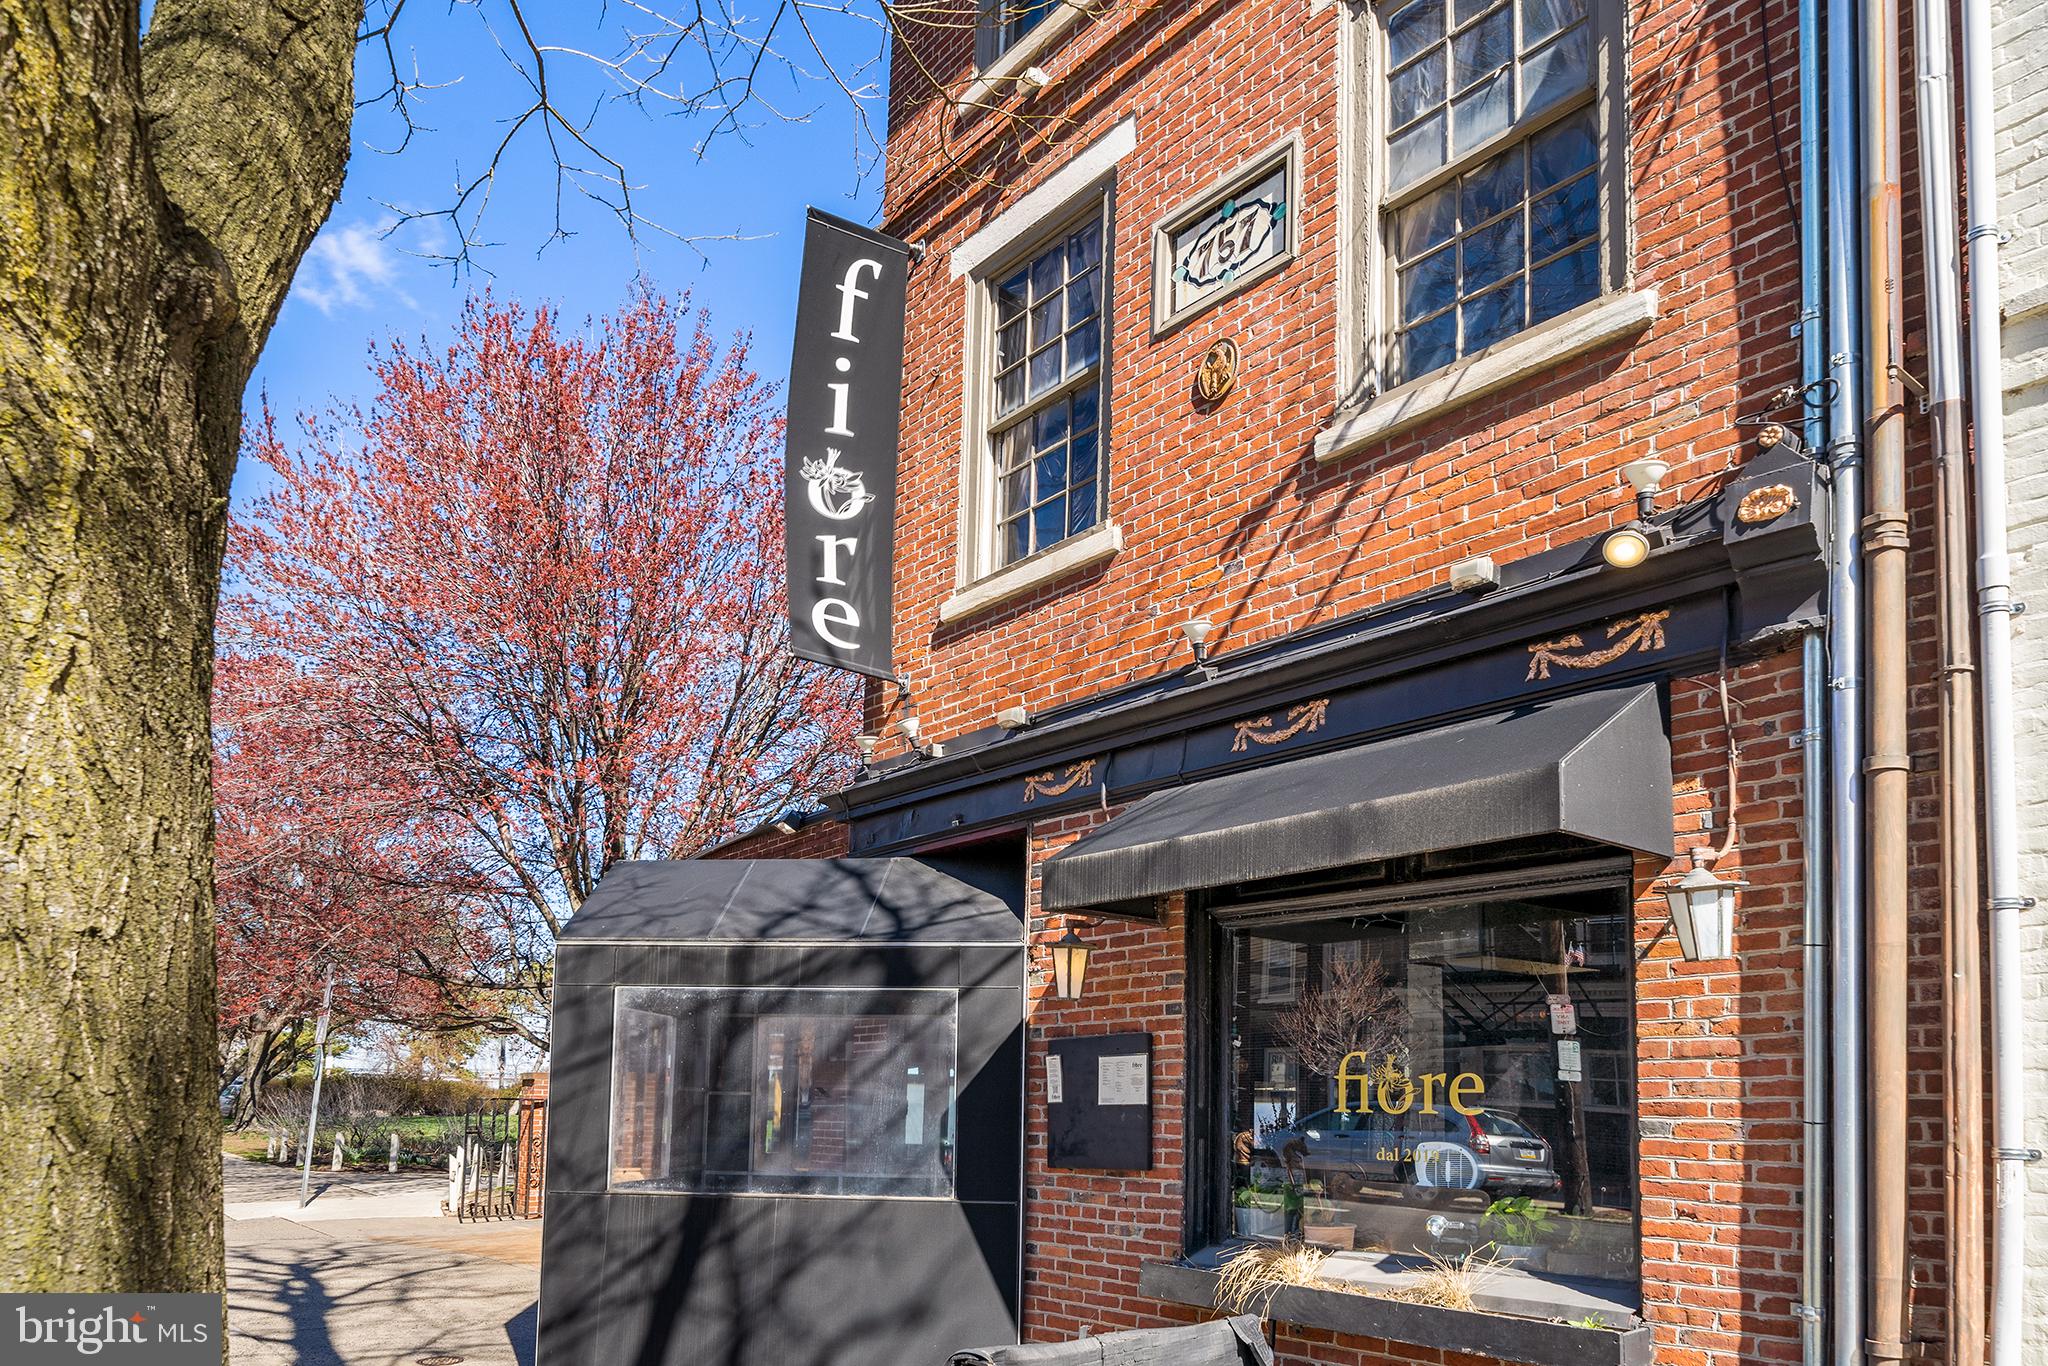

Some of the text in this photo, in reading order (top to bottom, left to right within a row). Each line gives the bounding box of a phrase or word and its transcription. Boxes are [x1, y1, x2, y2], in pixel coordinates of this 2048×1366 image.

[1198, 207, 1260, 279] 757
[804, 258, 883, 650] fiore
[1333, 1051, 1485, 1116] fiore
[1376, 1146, 1400, 1162] dal
